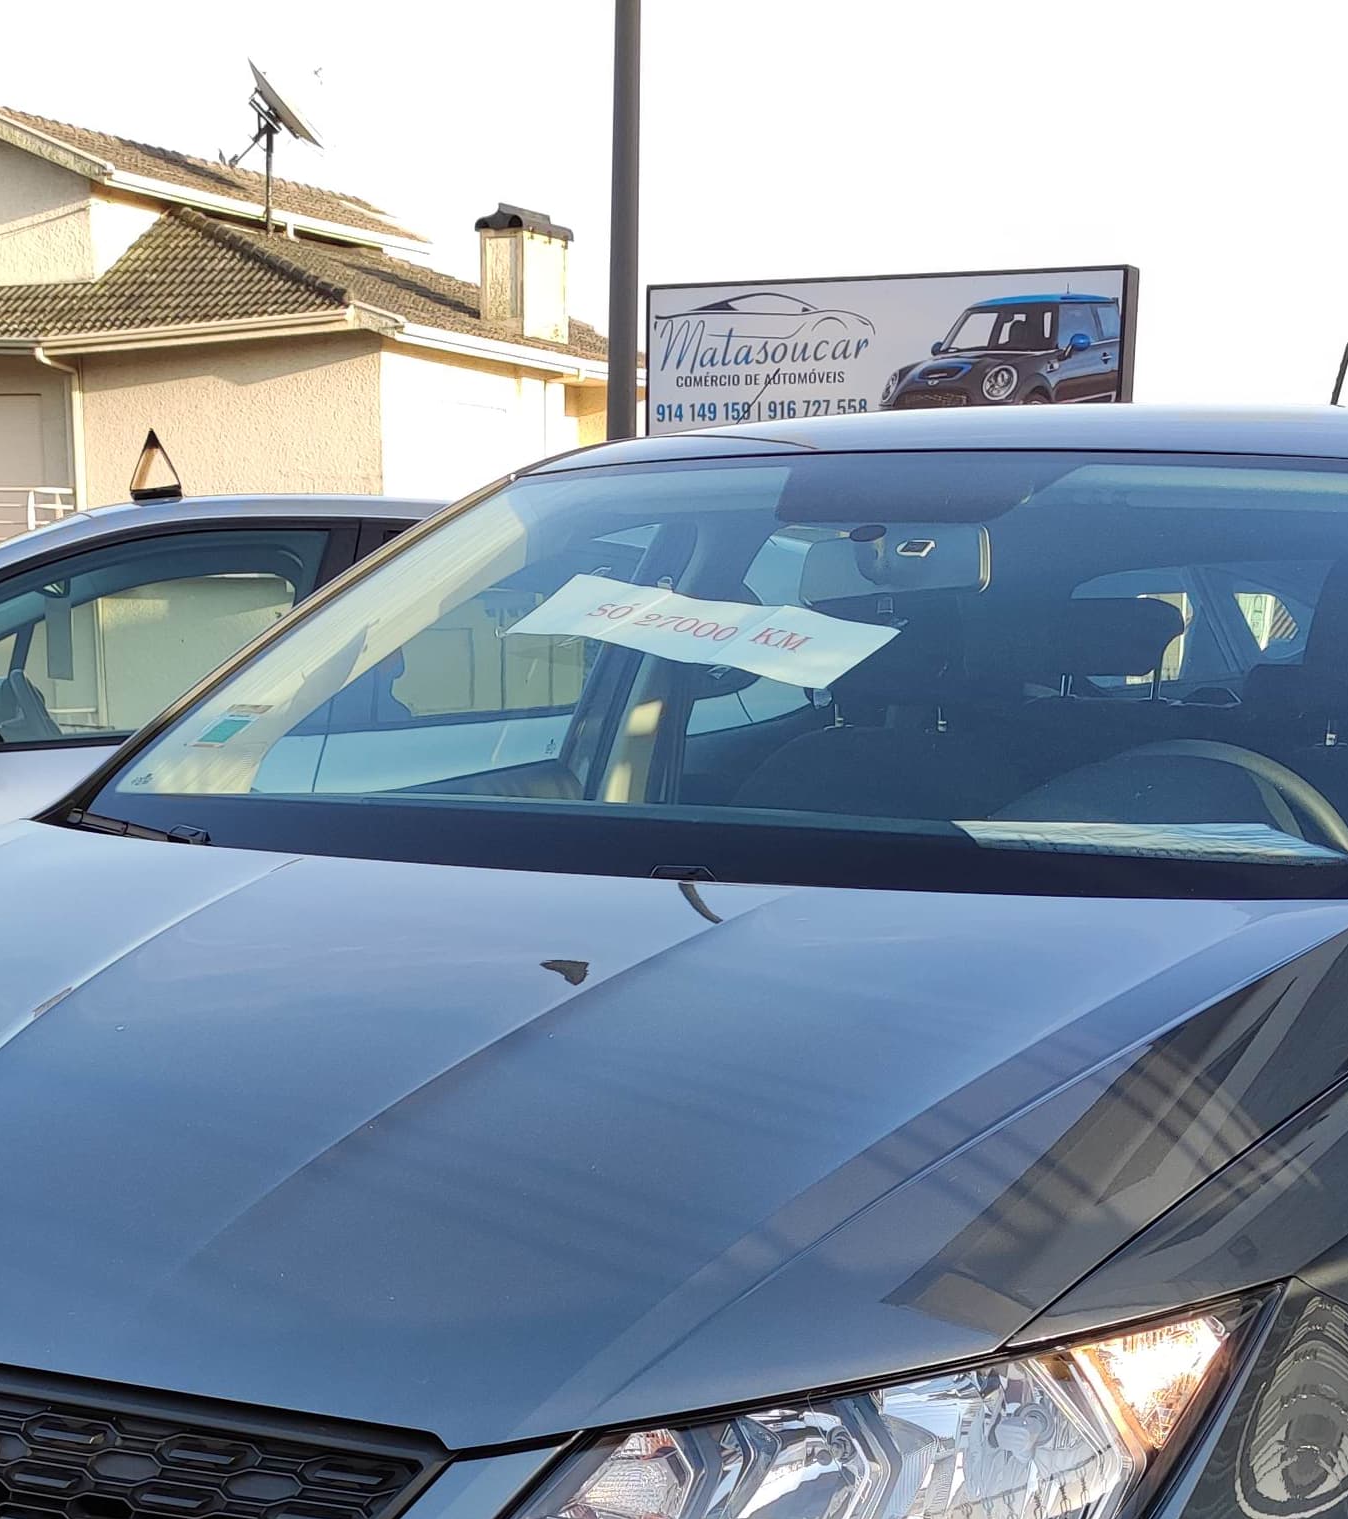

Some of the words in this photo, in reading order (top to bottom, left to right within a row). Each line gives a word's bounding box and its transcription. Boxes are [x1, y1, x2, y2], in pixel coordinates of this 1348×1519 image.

[660, 319, 870, 374] Matasoucar
[676, 371, 740, 388] COMÉRCIO
[744, 373, 760, 387] DE
[765, 368, 845, 386] AUTOMÓVEIS
[656, 402, 684, 423] 914
[689, 401, 717, 422] 149
[767, 400, 797, 420] 916
[802, 399, 831, 418] 727
[587, 602, 639, 620] SÓ
[633, 613, 739, 642] 27000
[749, 627, 813, 652] KM
